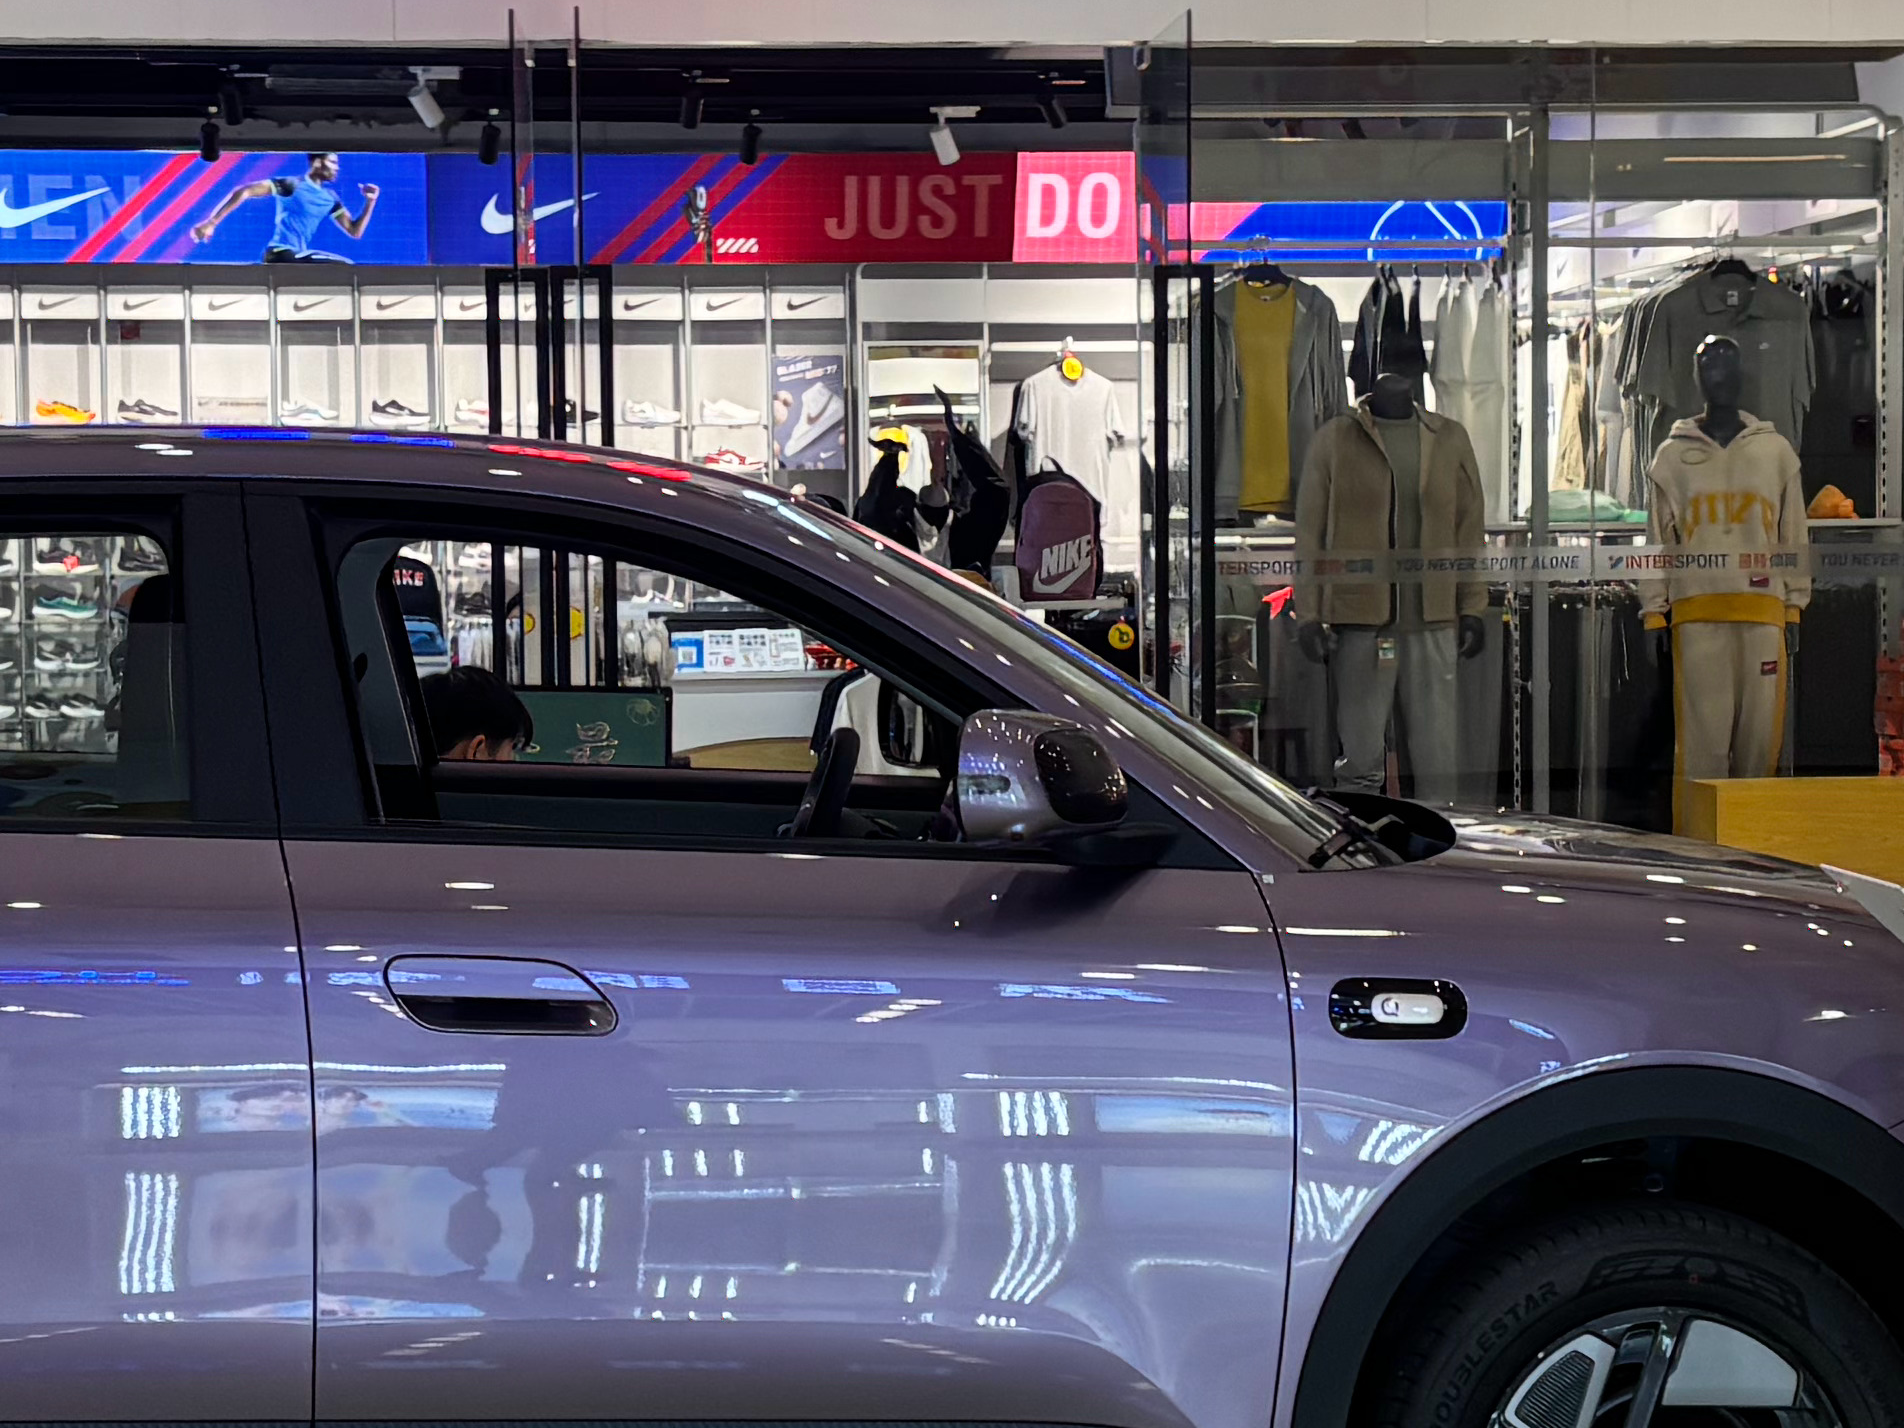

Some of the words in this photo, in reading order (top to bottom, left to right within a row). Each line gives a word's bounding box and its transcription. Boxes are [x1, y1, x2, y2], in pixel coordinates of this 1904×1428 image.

[824, 175, 1003, 241] JUST
[1025, 172, 1121, 240] DO
[1040, 534, 1092, 580] NIKE
[1624, 553, 1729, 570] INTERSPORT
